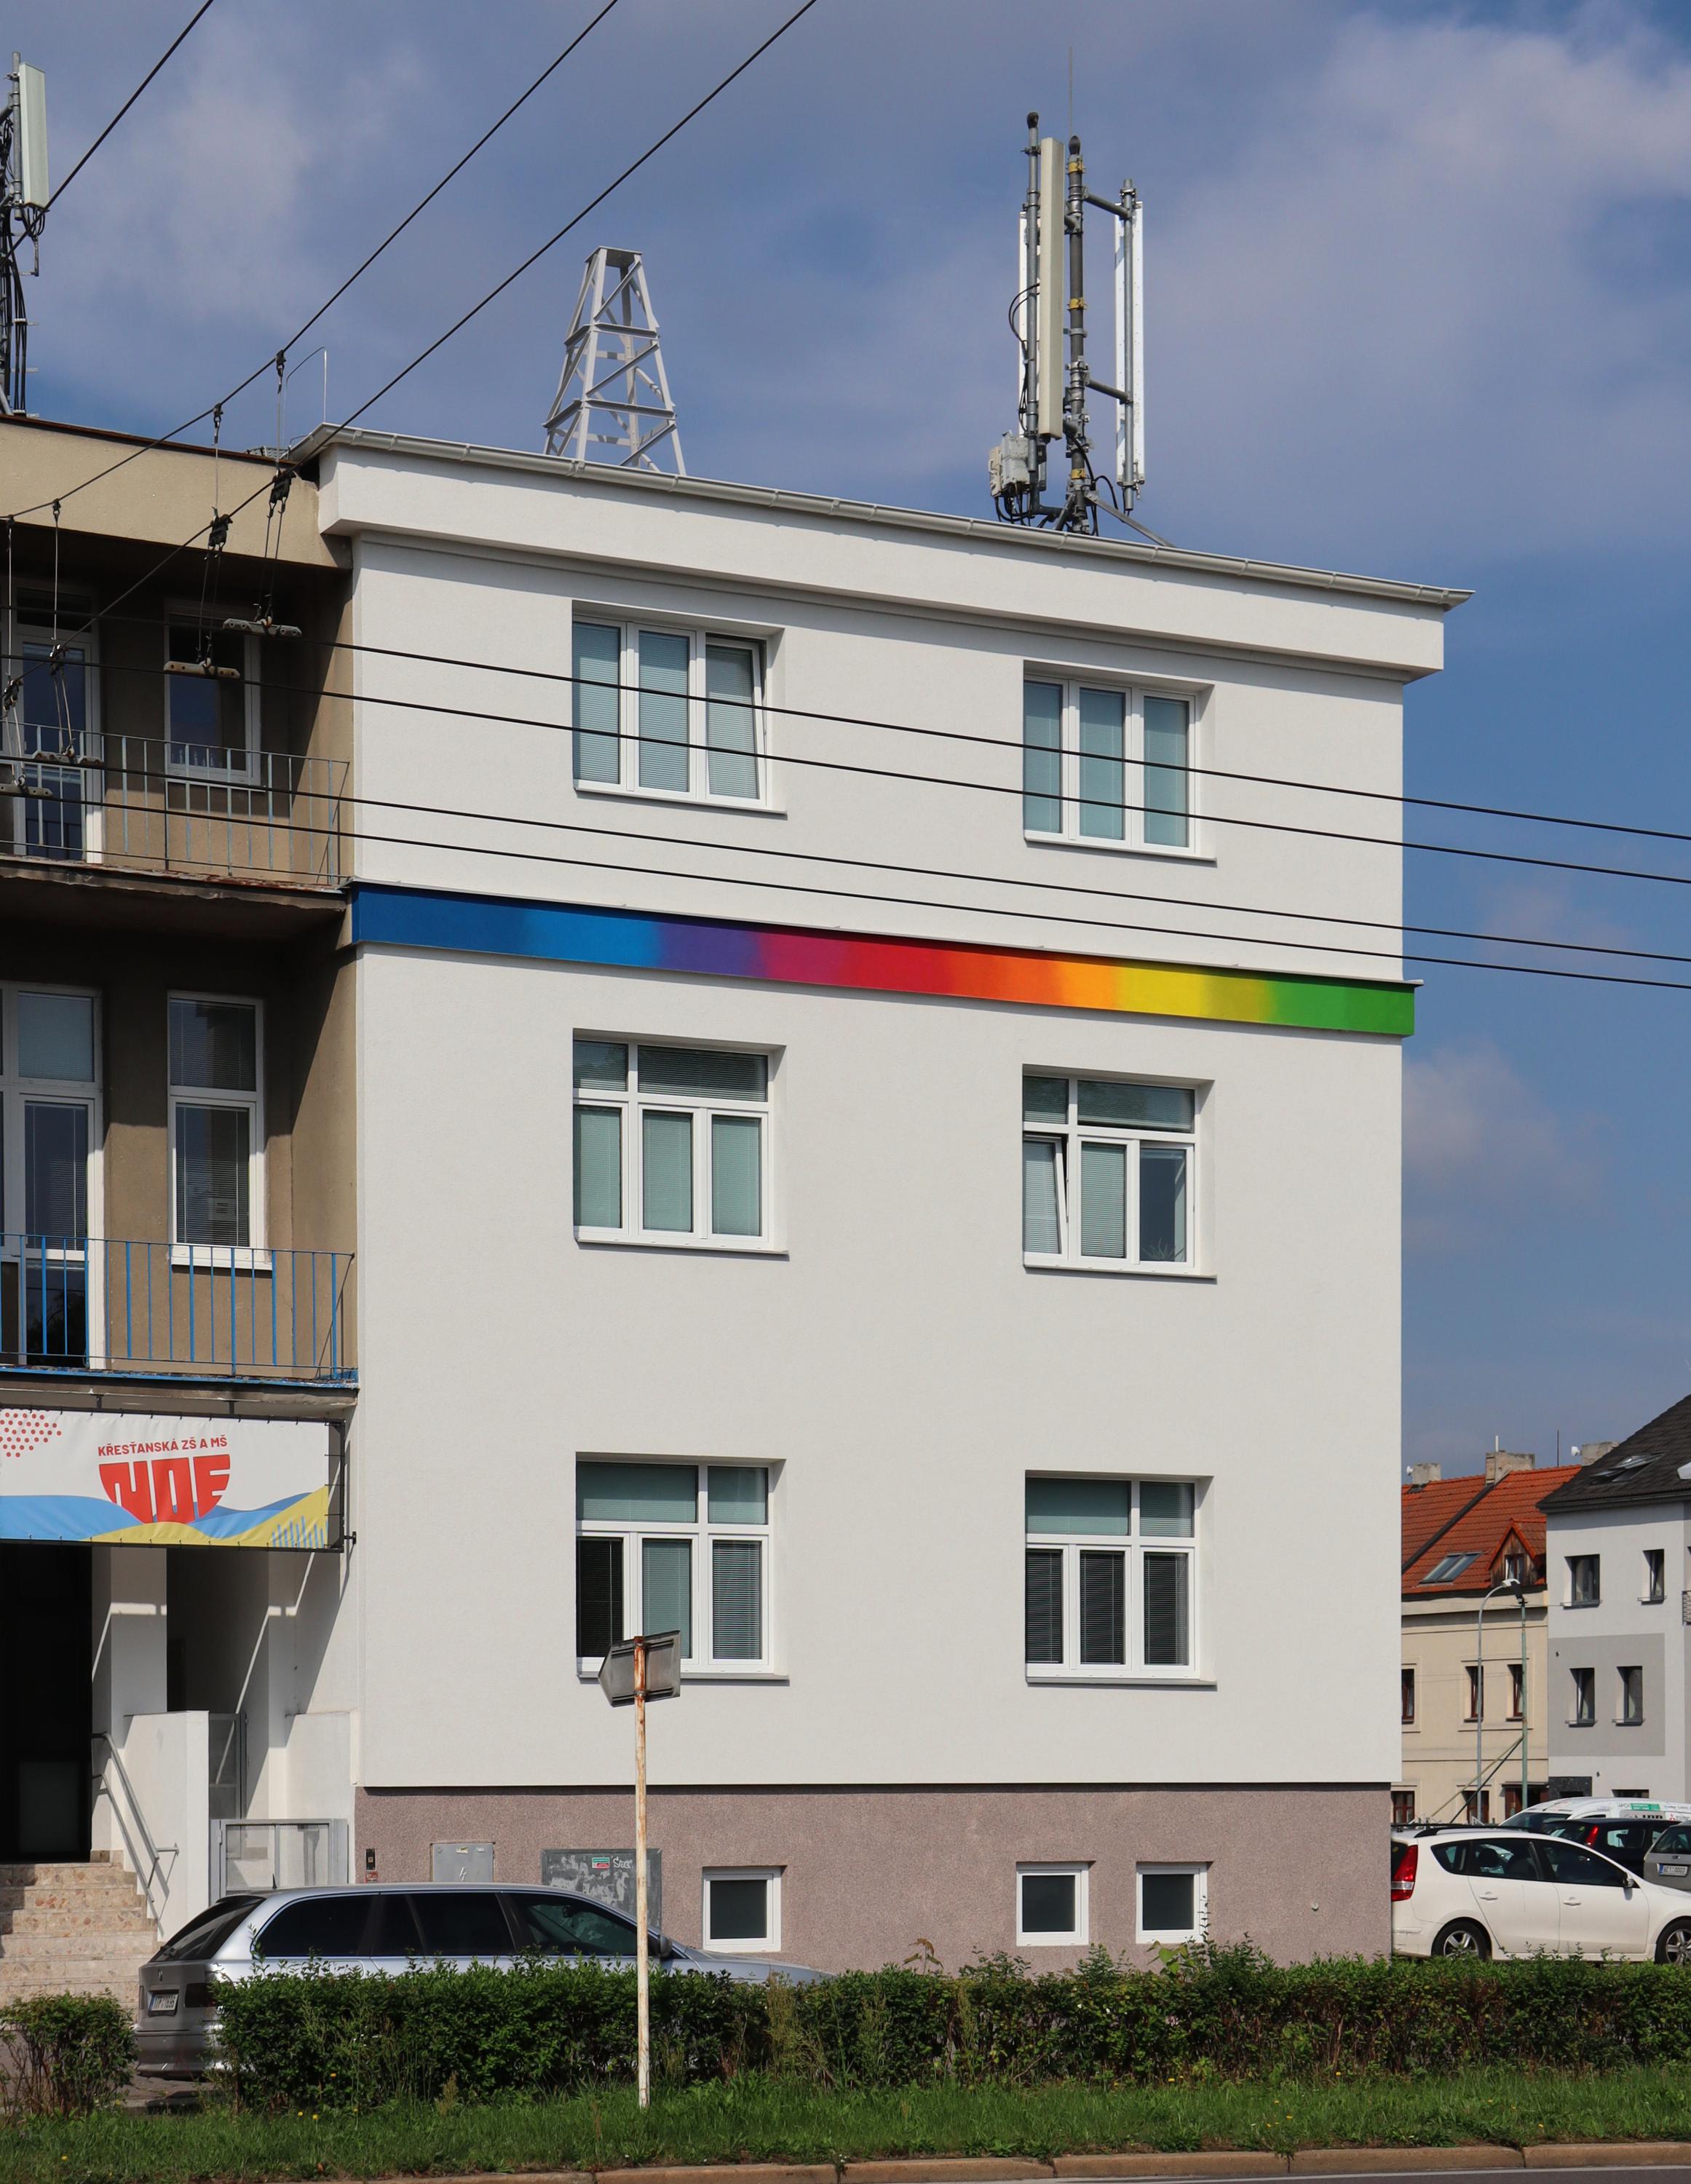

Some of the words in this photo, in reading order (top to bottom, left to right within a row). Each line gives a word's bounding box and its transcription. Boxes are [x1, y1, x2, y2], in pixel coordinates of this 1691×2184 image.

[98, 1438, 179, 1456] KŘESŤANSKÁ
[181, 1436, 197, 1450] ZŠ
[199, 1438, 208, 1449] A
[211, 1434, 228, 1448] MŠ
[98, 1454, 231, 1524] NOE
